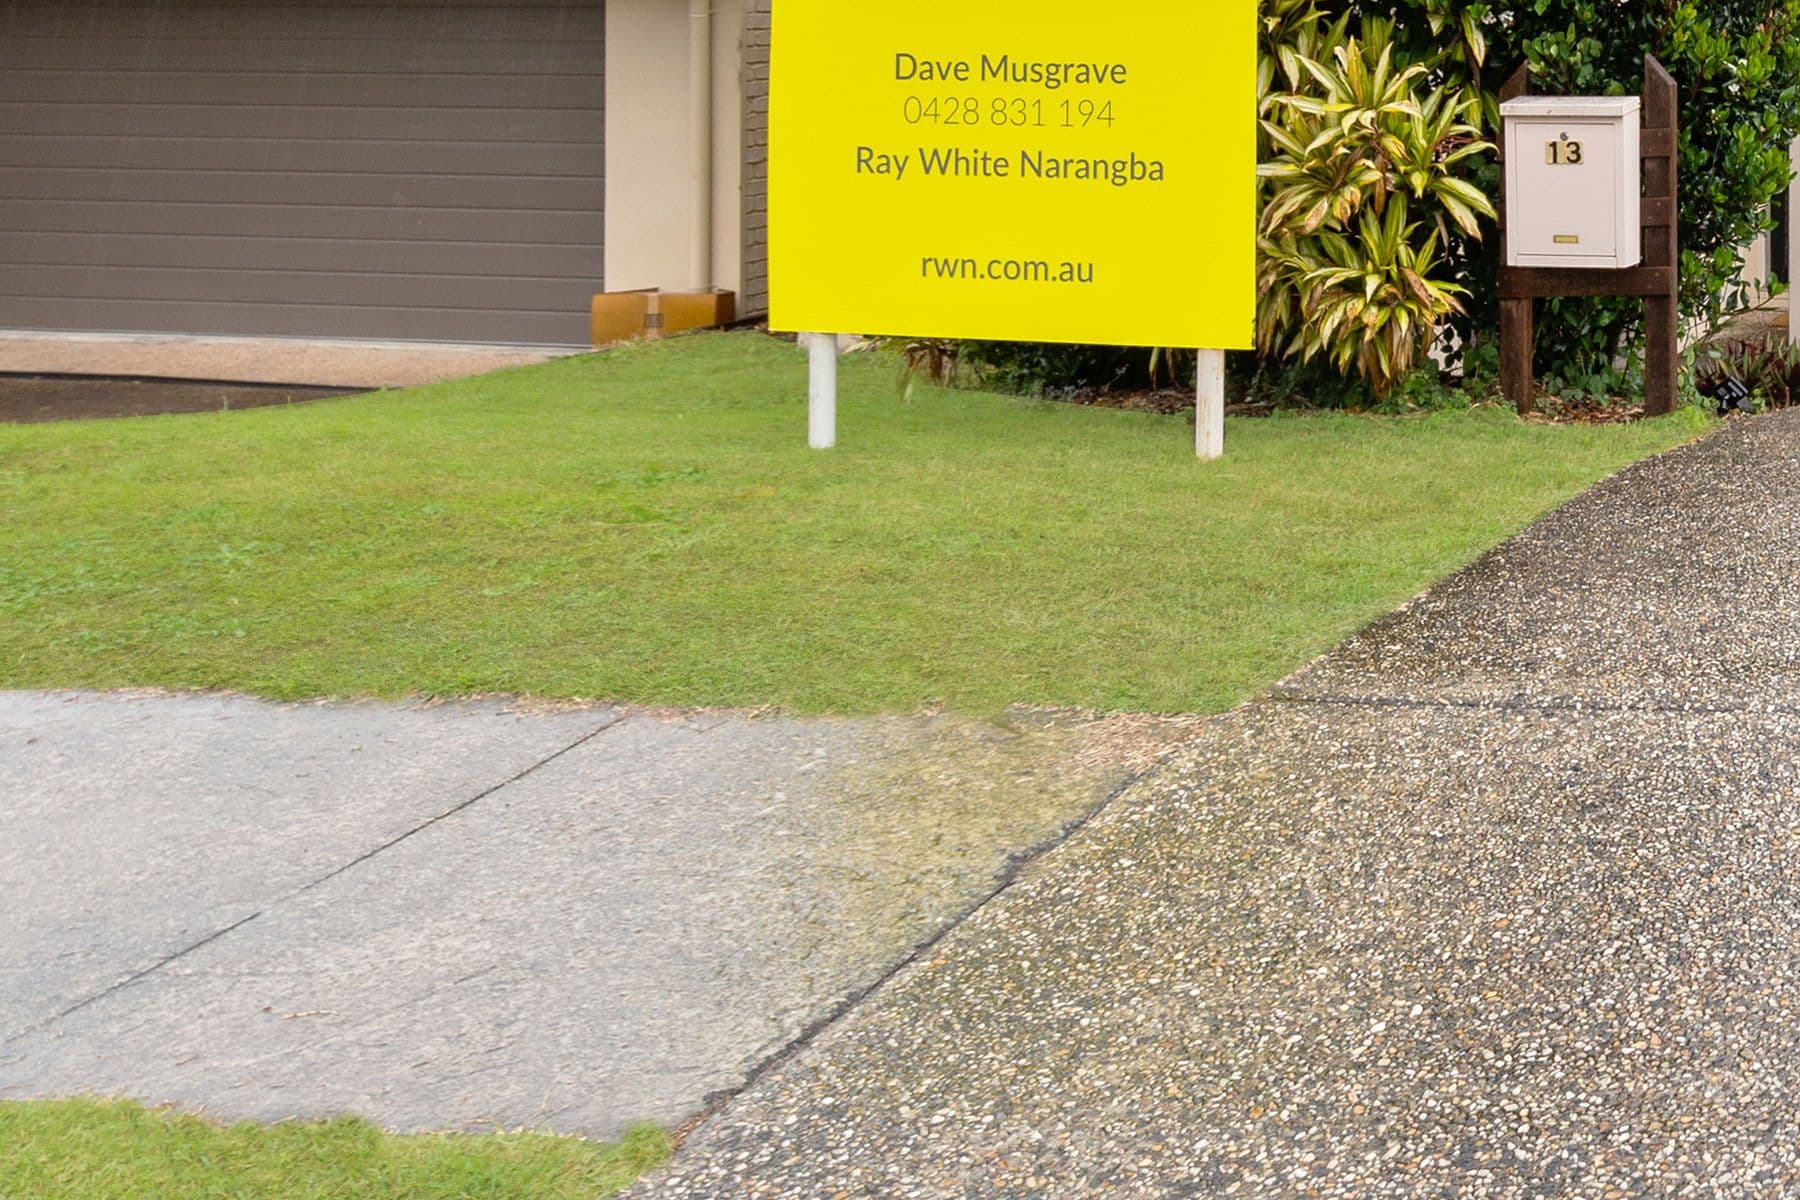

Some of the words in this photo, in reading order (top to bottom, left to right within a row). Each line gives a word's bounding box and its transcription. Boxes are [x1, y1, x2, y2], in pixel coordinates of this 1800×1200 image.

[895, 52, 970, 82] Dave
[980, 53, 1127, 89] Musgrave
[903, 95, 980, 126] 0428
[990, 97, 1046, 127] 831
[1059, 99, 1116, 128] 194
[856, 146, 909, 181] Ray
[918, 147, 1010, 178] White
[1020, 150, 1164, 187] Narangba
[1548, 141, 1581, 164] 13
[921, 256, 1094, 283] rwn.com.au
